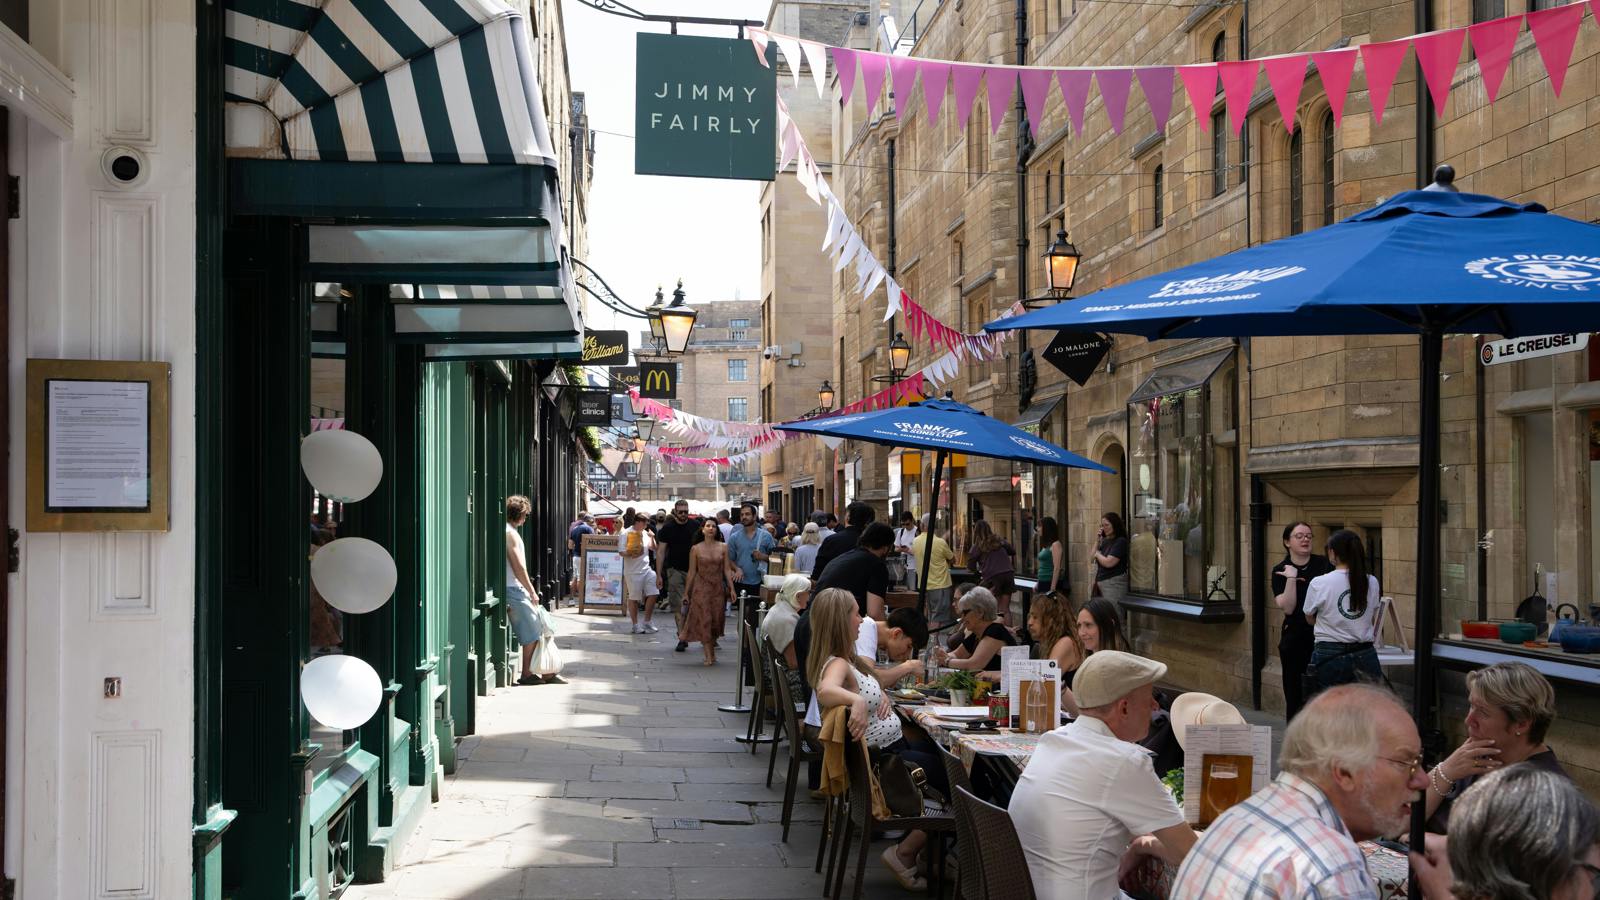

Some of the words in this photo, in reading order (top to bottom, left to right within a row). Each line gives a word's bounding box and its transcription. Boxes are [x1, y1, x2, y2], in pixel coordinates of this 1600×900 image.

[654, 82, 757, 103] JIMMY
[651, 113, 760, 134] FAIRLY
[1065, 342, 1101, 352] MALONE
[1499, 344, 1515, 357] LE
[1517, 333, 1577, 353] CREUSET
[582, 408, 605, 416] clinics
